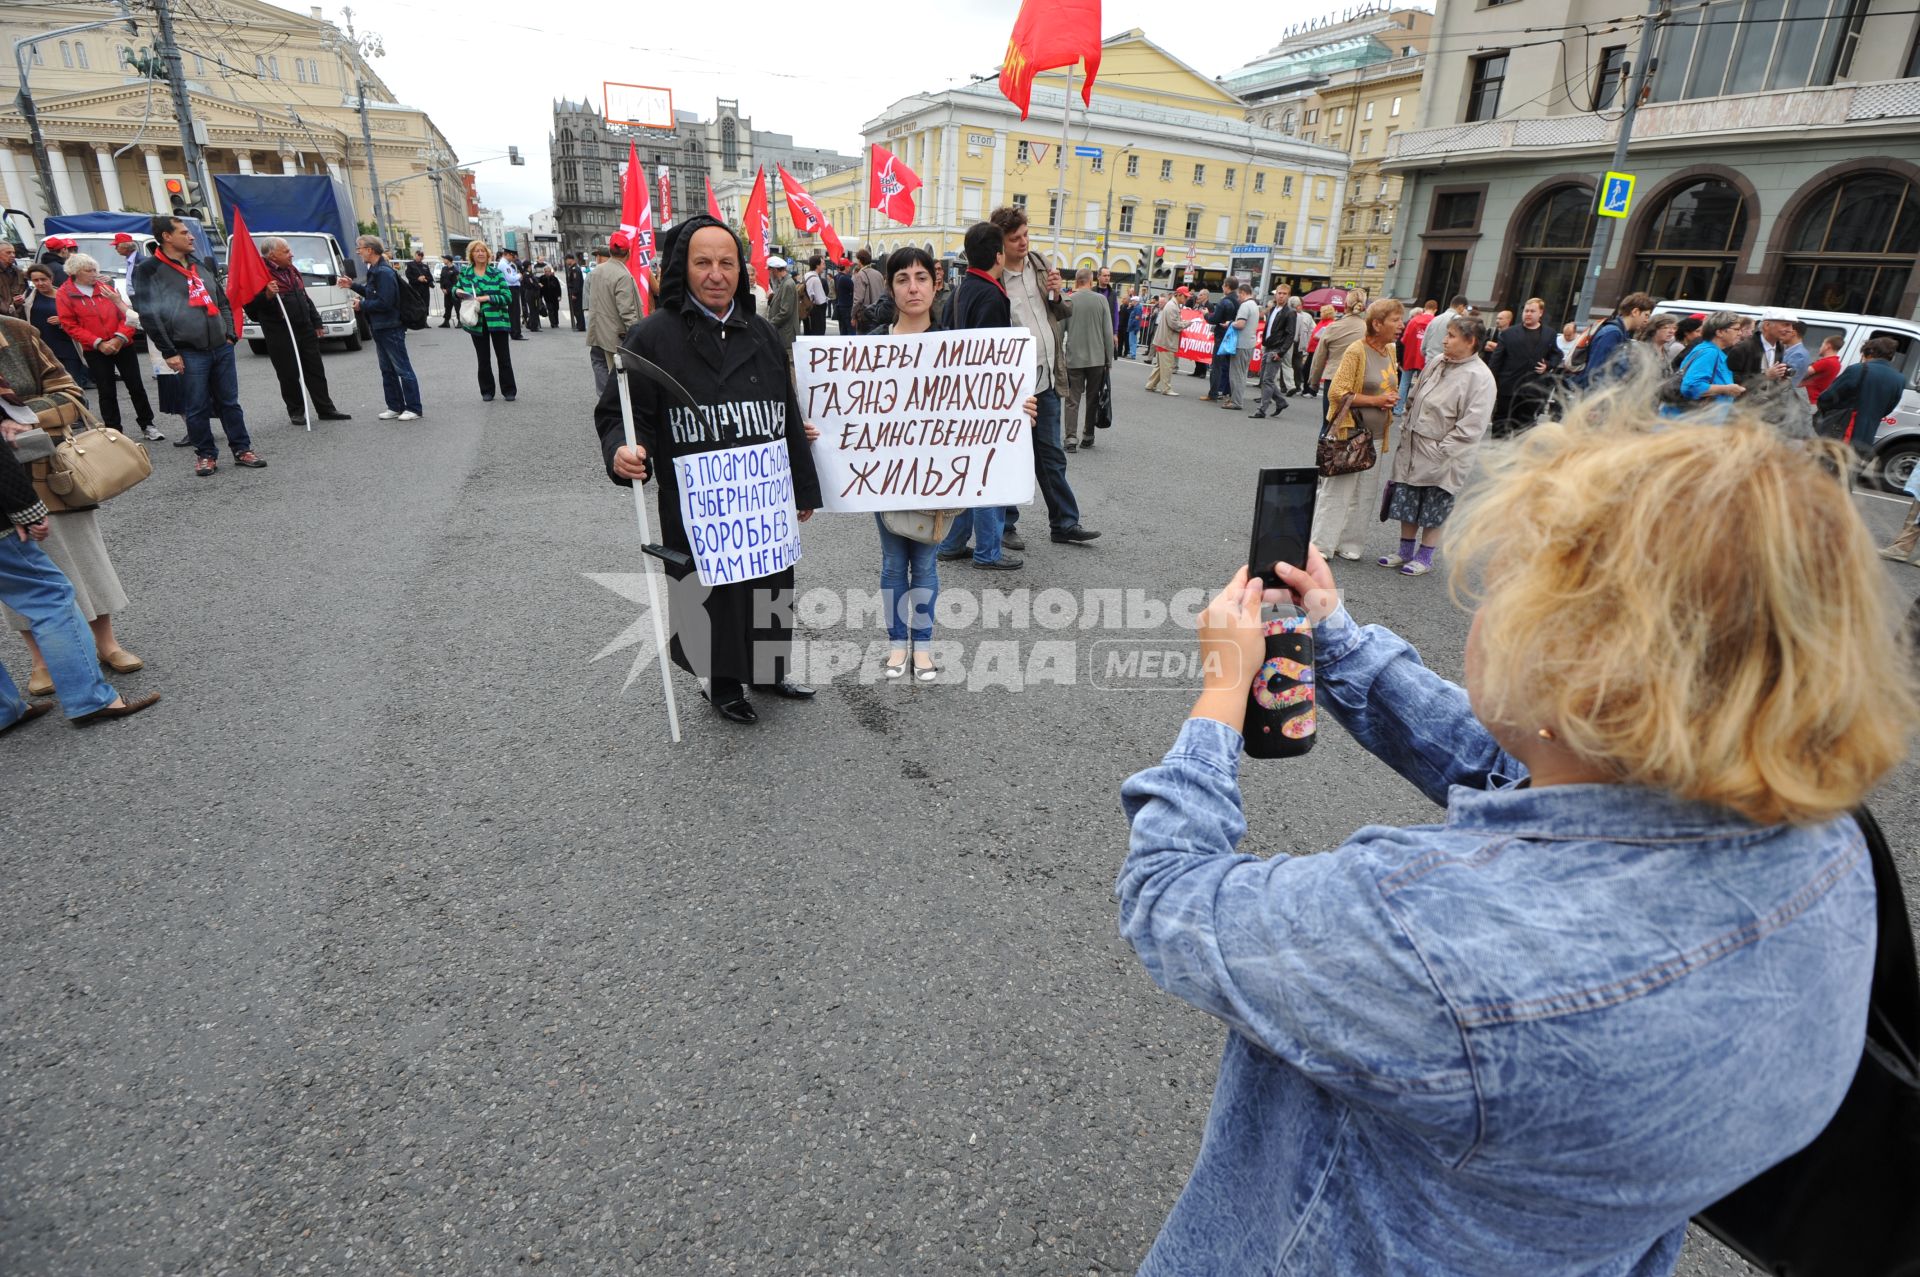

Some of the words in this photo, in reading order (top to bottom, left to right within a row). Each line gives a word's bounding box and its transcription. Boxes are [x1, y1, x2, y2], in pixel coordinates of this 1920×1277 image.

[1282, 11, 1338, 41] ARARAT
[970, 135, 992, 145] СТОП
[809, 341, 922, 373] РЕЙДЕРЫ
[934, 338, 1030, 368] ЛИШАЮТ
[808, 378, 898, 418] ГАЯНЭ
[904, 372, 1025, 412] АМРАХОВУ
[839, 418, 1022, 452] ЕДИНСТВЕННОГО
[684, 463, 694, 488] В
[700, 554, 745, 584] НАМ
